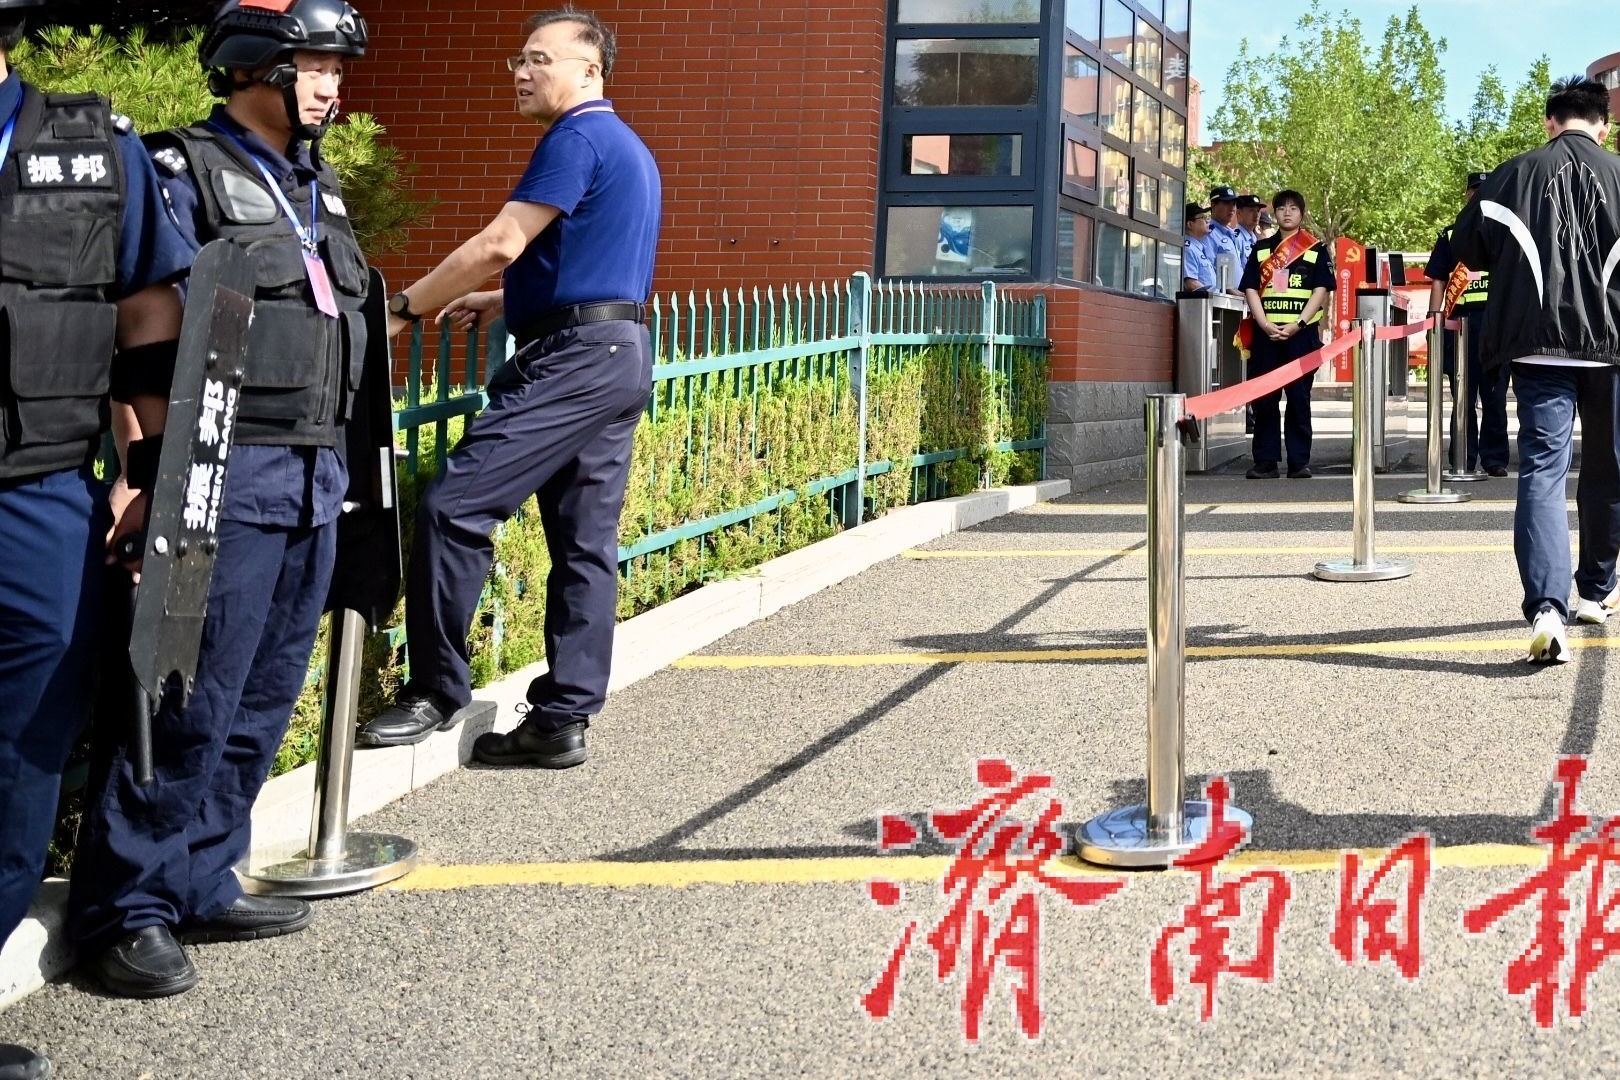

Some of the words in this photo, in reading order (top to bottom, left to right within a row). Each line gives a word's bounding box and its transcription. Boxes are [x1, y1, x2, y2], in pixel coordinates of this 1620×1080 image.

[26, 153, 107, 184] 振邦
[1263, 300, 1305, 311] SECURITY
[206, 464, 225, 534] ZHEN
